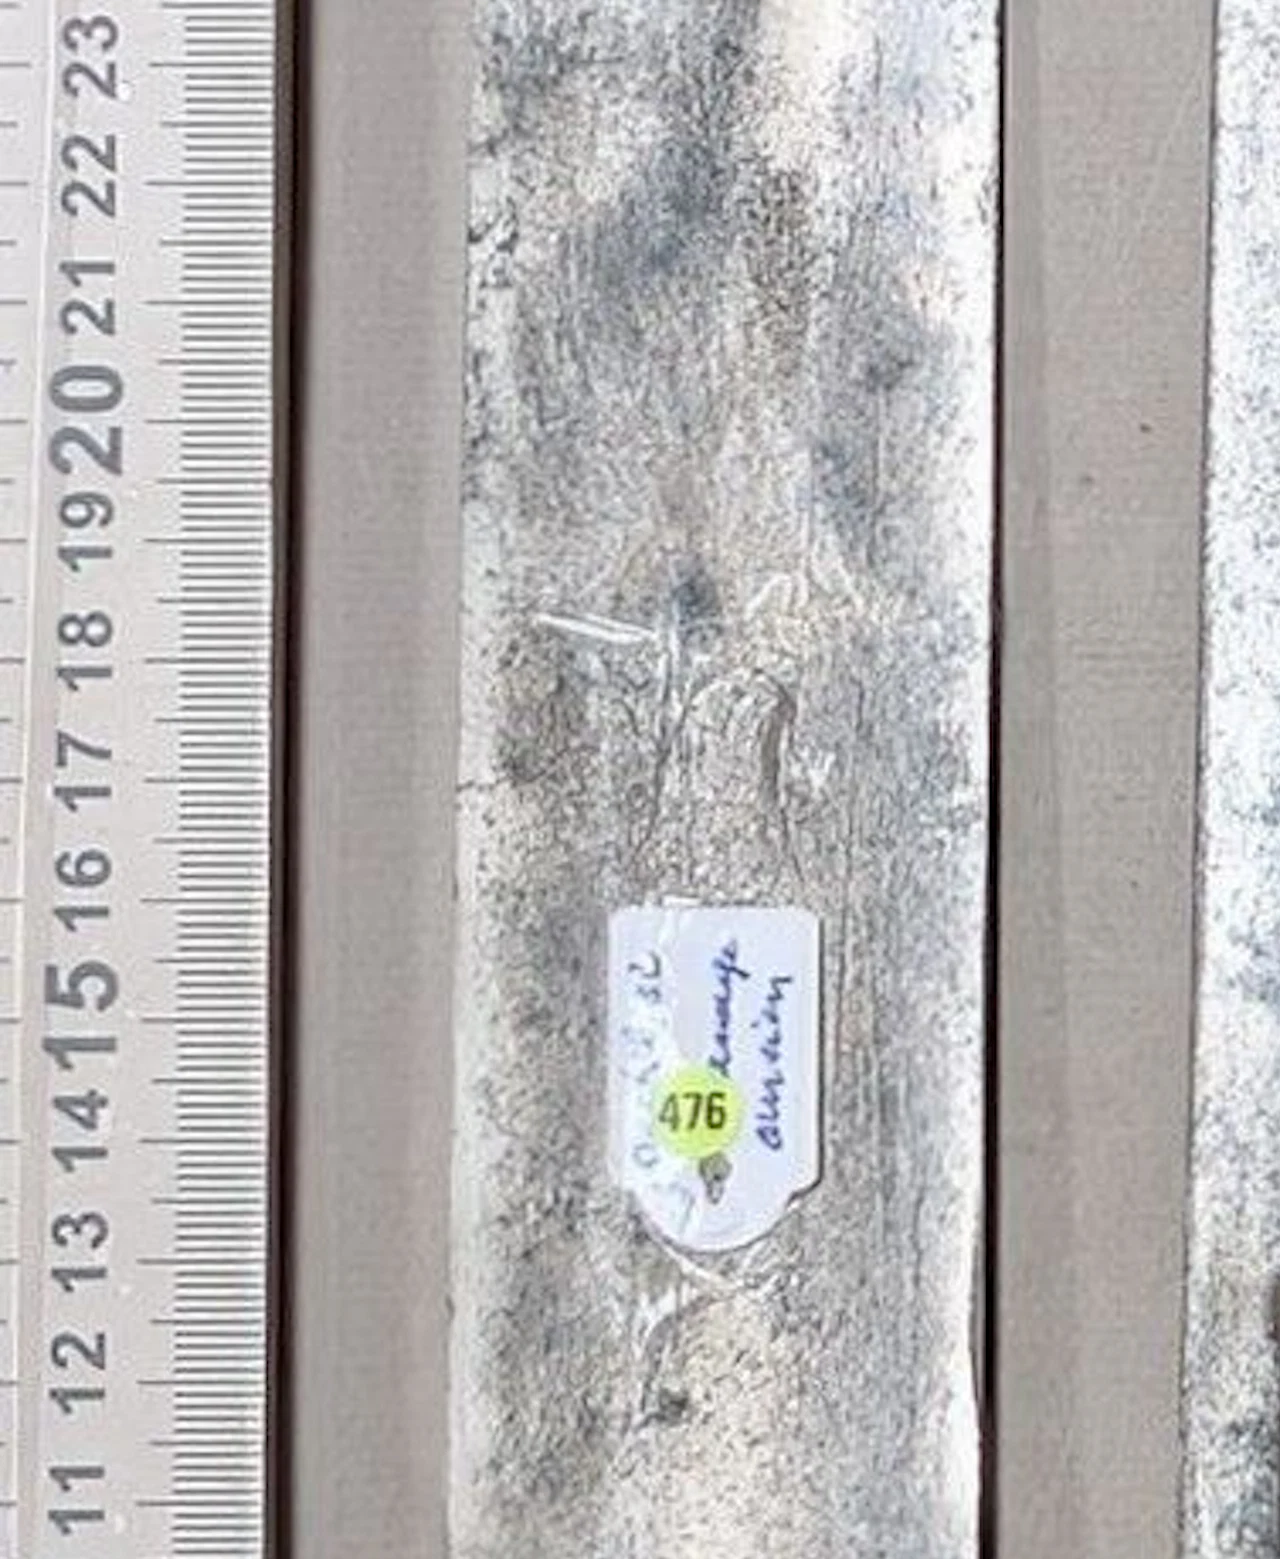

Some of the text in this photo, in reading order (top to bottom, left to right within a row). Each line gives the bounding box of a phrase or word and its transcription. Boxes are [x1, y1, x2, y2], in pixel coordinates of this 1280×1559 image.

[61, 15, 118, 99] 23
[60, 135, 116, 218] 22
[59, 259, 115, 336] 21
[48, 364, 123, 475] 20
[58, 491, 114, 572] 19
[56, 611, 113, 691] 18
[53, 731, 111, 812] 17
[53, 849, 111, 932] 16
[42, 961, 119, 1070] 15
[52, 1089, 109, 1172] 14
[658, 1091, 728, 1133] 476
[51, 1211, 108, 1292] 13
[49, 1332, 105, 1414] 12
[48, 1465, 105, 1535] 11
